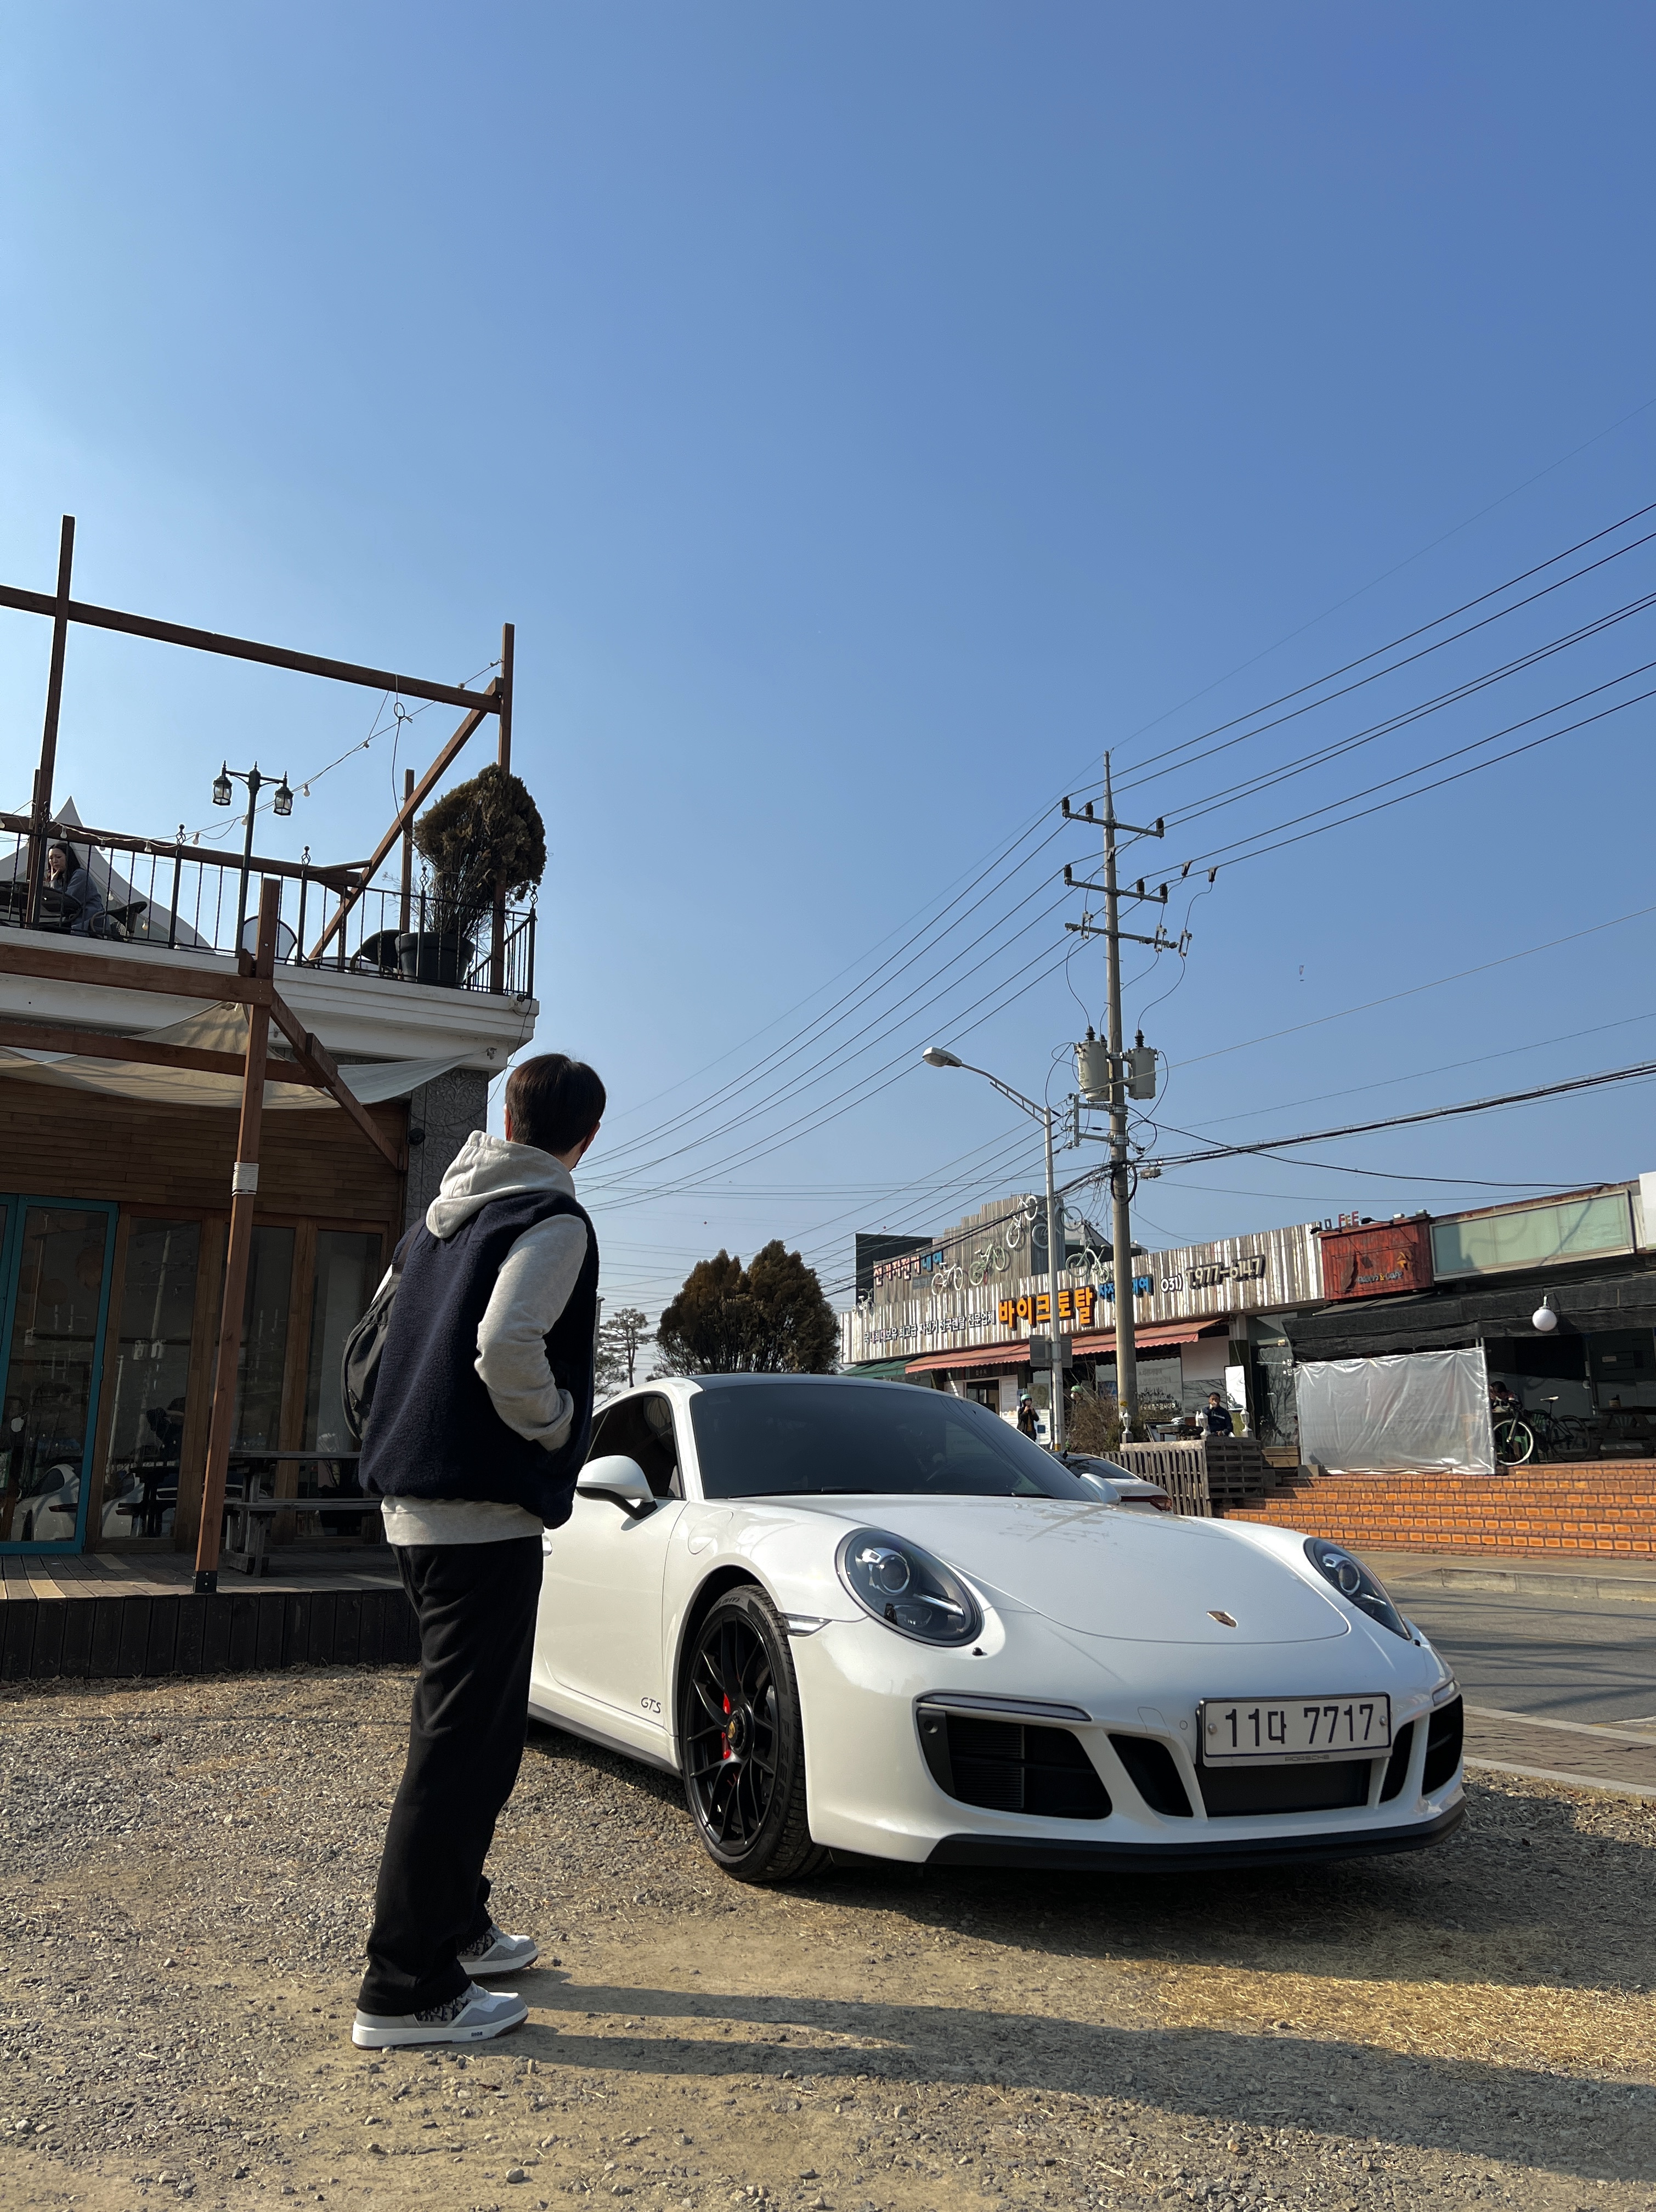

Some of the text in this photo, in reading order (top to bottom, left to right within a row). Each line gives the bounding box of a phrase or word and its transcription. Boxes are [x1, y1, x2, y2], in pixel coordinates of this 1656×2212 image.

[1161, 1273, 1183, 1293] 031)
[998, 1286, 1093, 1328] 바이크토탈
[899, 1324, 917, 1339] 최고급
[919, 1320, 938, 1335] 자전거
[940, 1316, 966, 1333] 전국렌탈
[968, 1311, 995, 1327] 전문업체
[641, 1697, 661, 1713] GTS
[1225, 1704, 1373, 1747] 11다 7717
